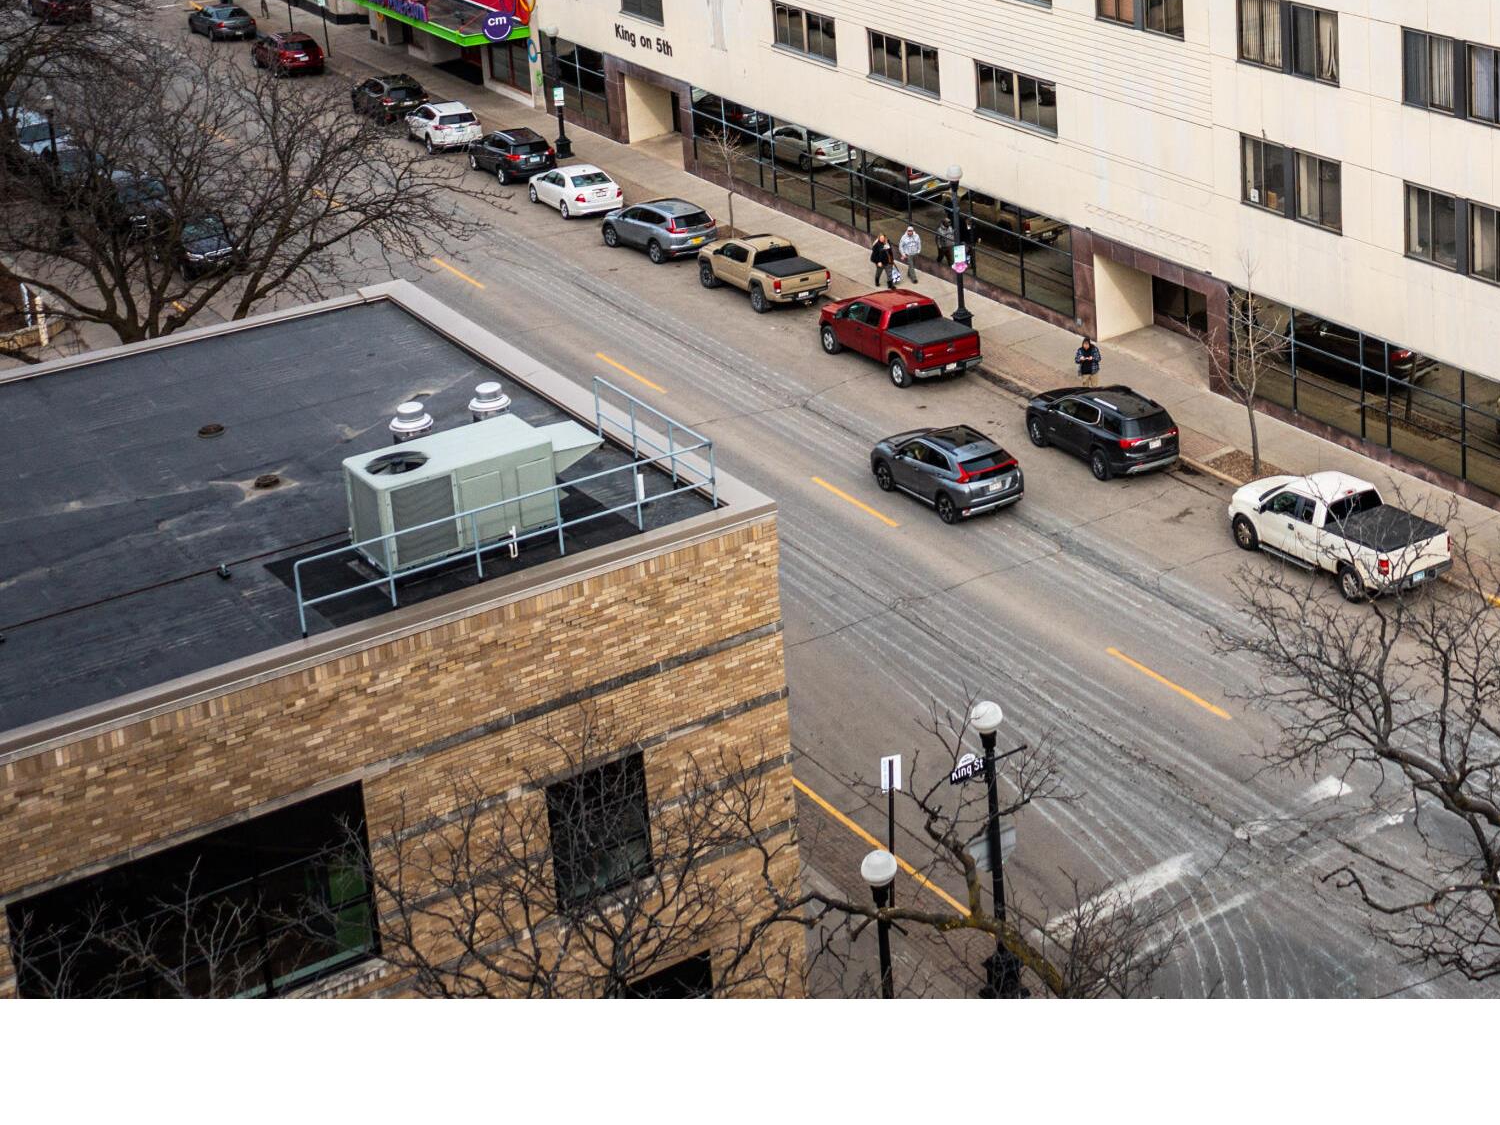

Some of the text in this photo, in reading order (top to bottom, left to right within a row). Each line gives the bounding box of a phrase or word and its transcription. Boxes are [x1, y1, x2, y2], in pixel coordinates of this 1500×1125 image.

[487, 15, 508, 27] cm
[614, 23, 673, 58] King on 5th
[951, 764, 973, 782] King
[973, 757, 984, 772] St
